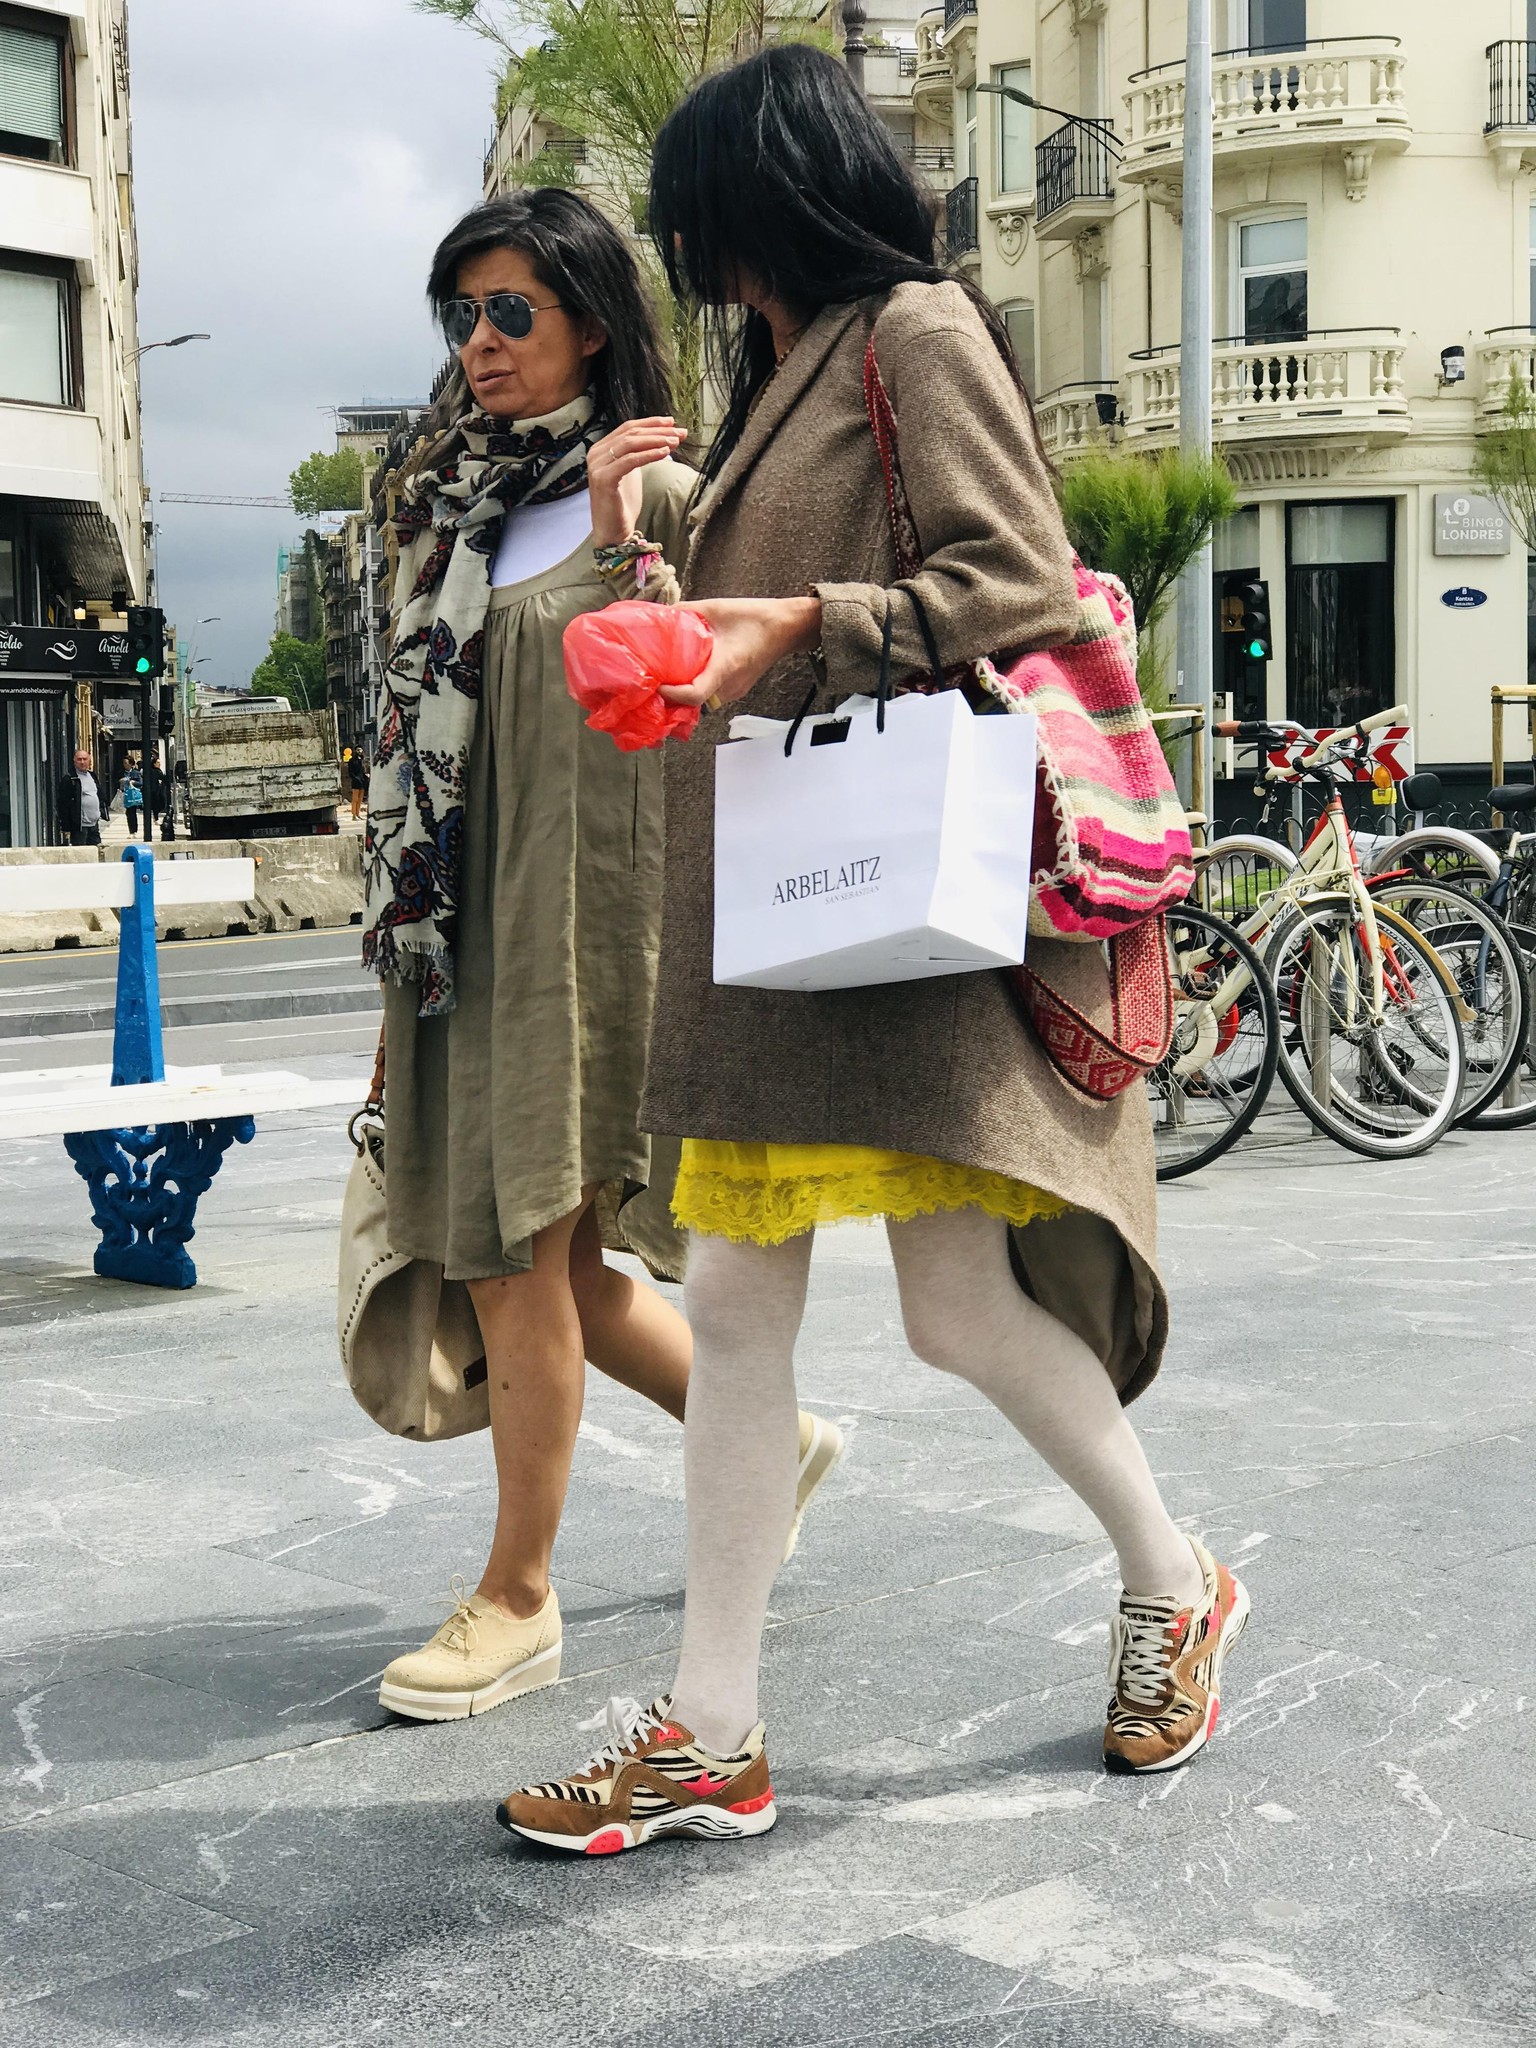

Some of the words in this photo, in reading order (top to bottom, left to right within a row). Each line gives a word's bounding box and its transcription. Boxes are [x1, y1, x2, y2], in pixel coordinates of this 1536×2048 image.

[1462, 517, 1504, 528] BINGO
[1442, 529, 1504, 540] LONDRES
[98, 638, 130, 654] Arnold
[771, 855, 882, 906] ARBELAITZ
